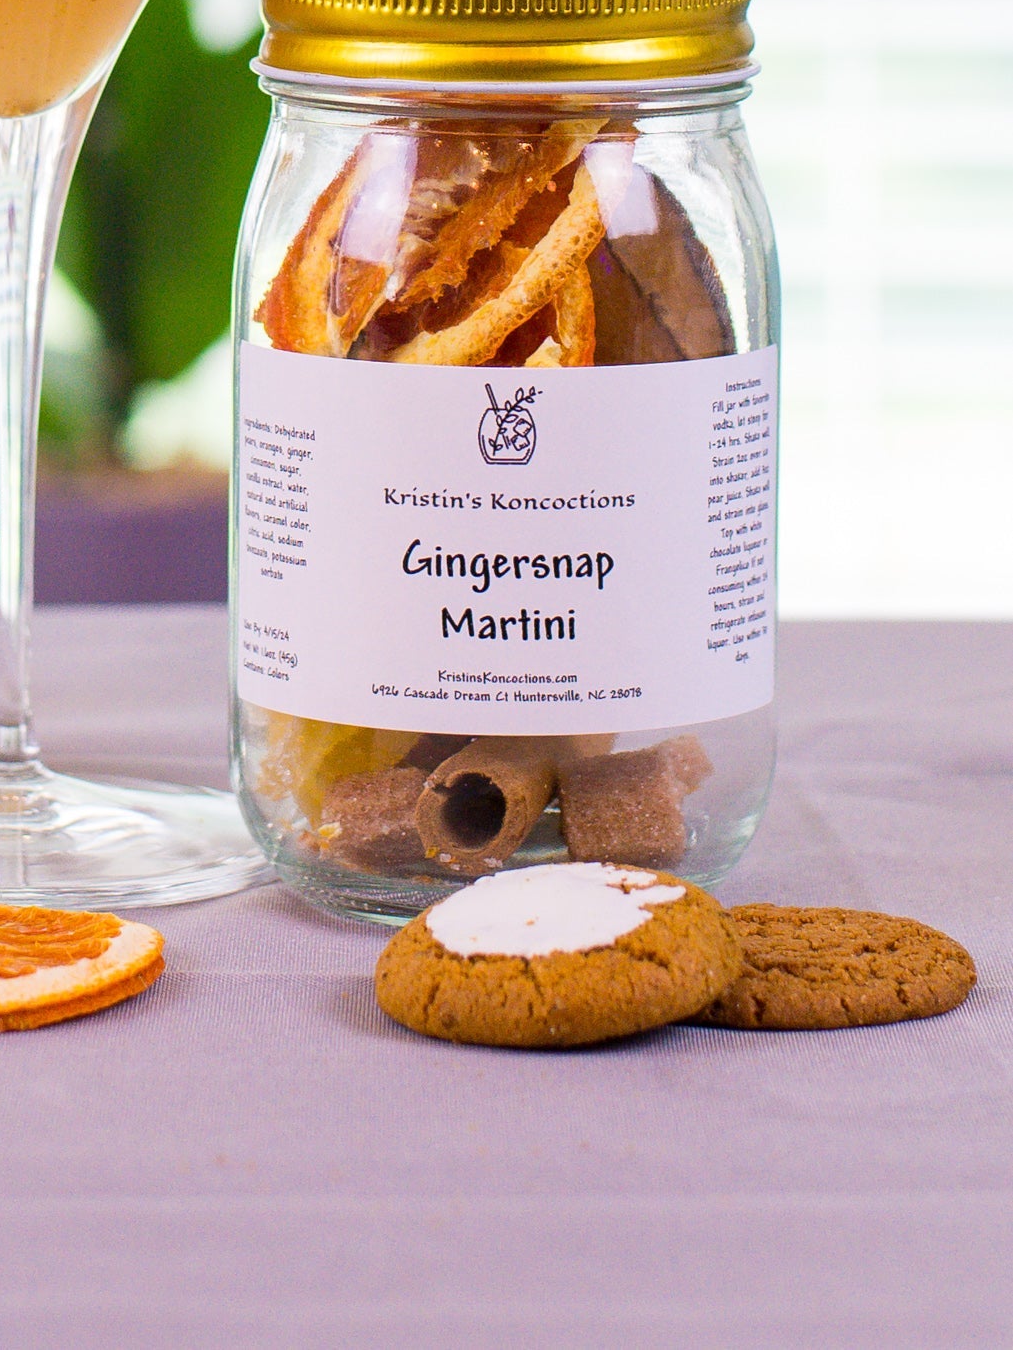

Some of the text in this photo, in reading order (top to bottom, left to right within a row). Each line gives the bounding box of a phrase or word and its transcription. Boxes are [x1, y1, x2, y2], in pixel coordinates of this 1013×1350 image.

[712, 400, 724, 413] Fill
[274, 425, 315, 441] Dehydrated
[278, 498, 308, 512] artificial
[384, 487, 636, 510] Kristin's Koncoctions
[708, 495, 724, 509] pear
[708, 509, 722, 523] and
[278, 534, 304, 548] sodium
[720, 527, 734, 541] Top
[271, 552, 307, 566] potassium
[402, 538, 615, 593] Gingersnap
[441, 607, 576, 641] Martini
[438, 669, 578, 684] KristinsKoncoctions.com
[371, 683, 643, 703] 6926 Cascade Dream Ct Huntersville, NC 28078
